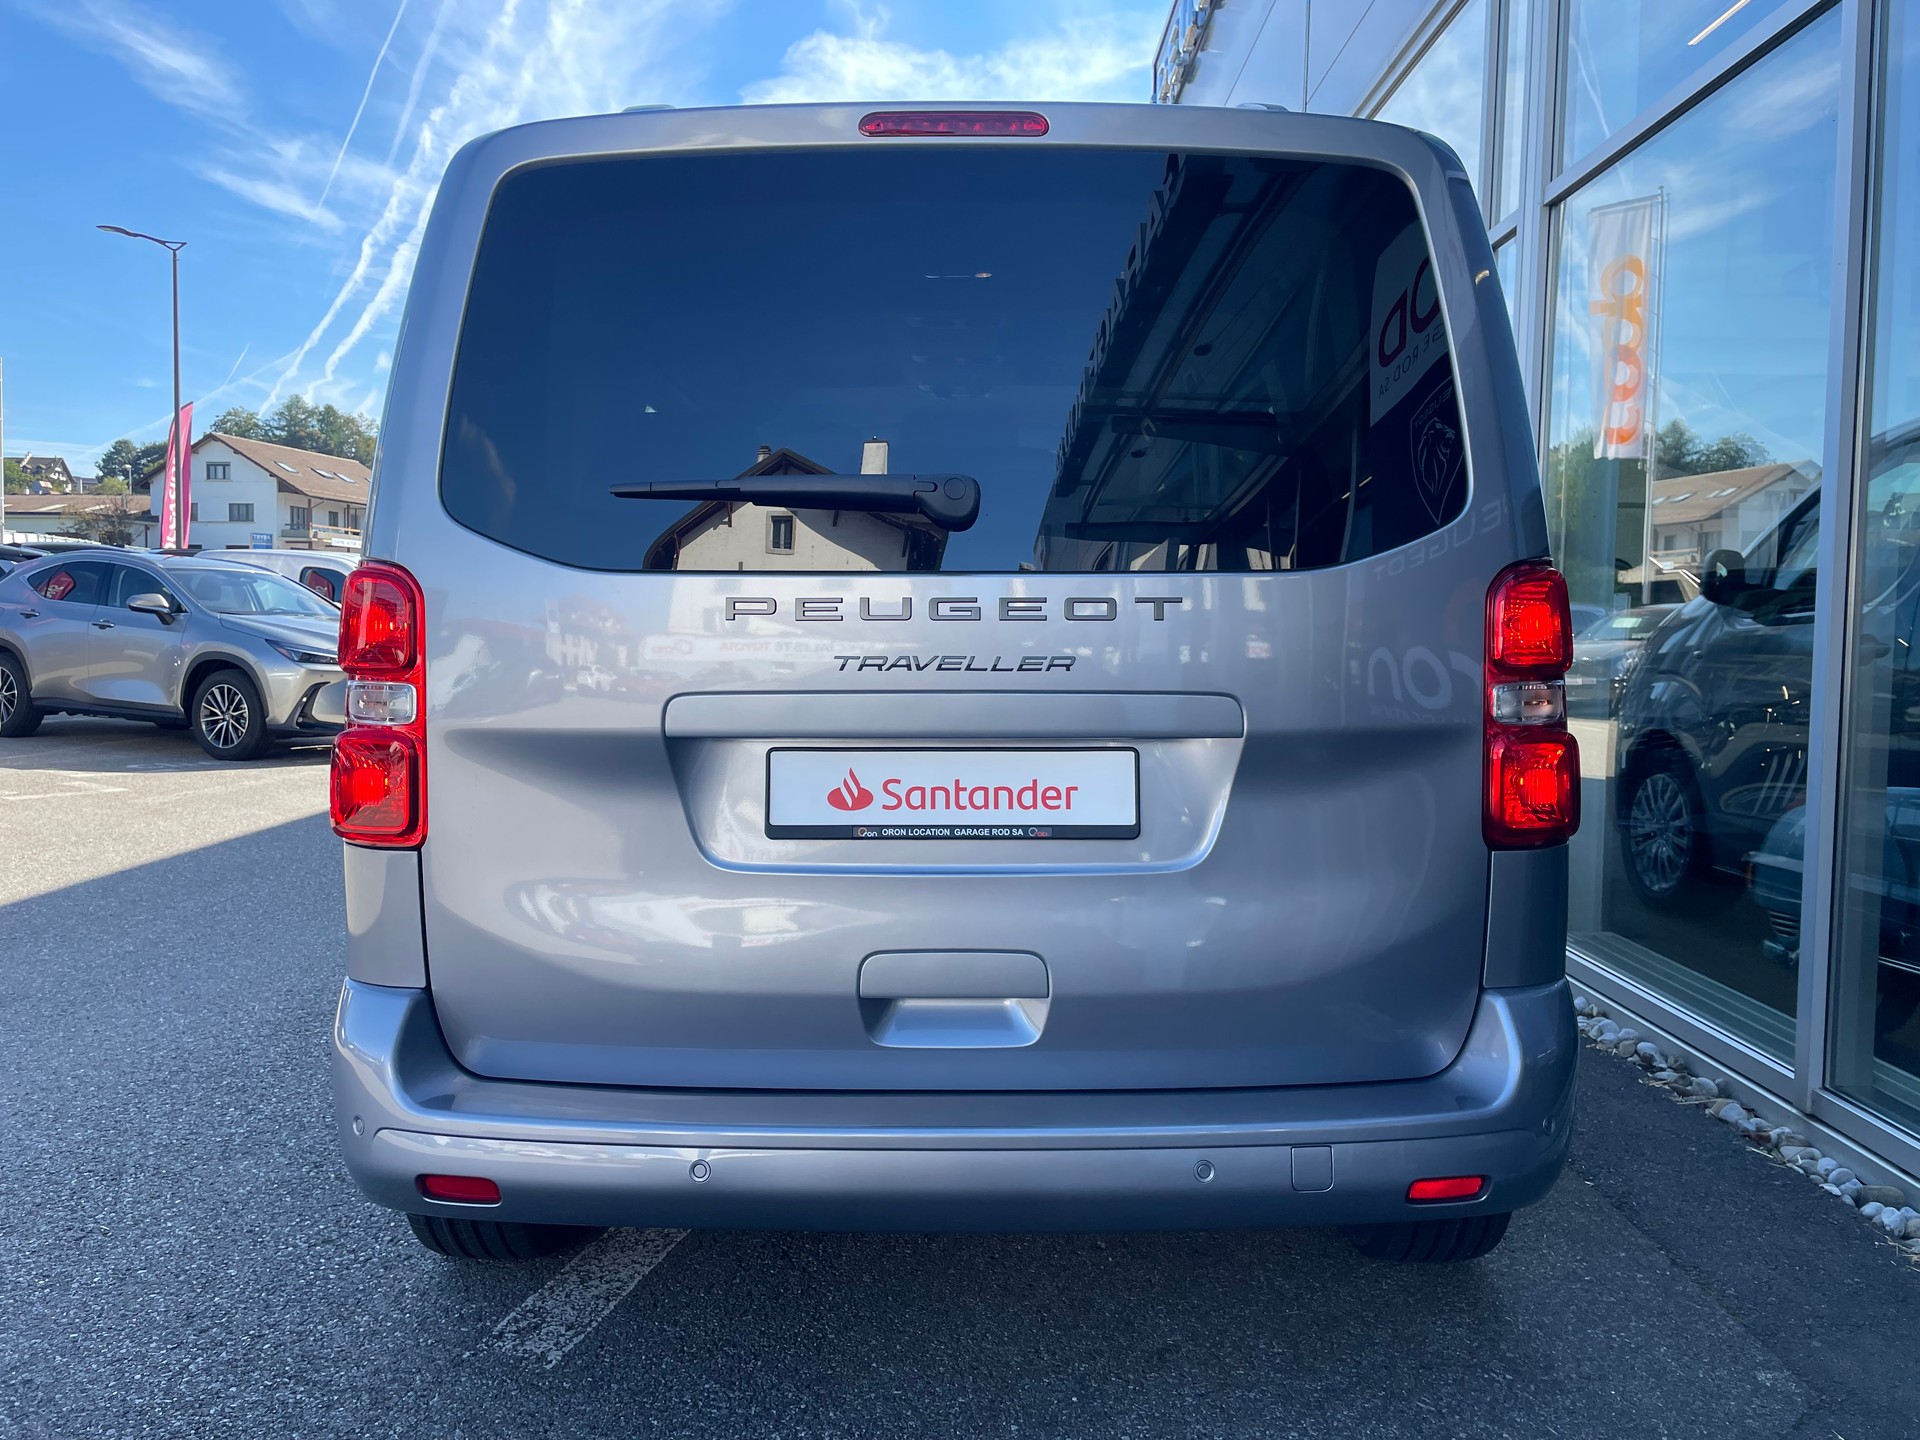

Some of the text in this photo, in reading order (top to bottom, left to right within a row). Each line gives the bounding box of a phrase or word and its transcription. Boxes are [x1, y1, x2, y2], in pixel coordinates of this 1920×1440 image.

[725, 596, 1183, 621] PEUGEOT
[833, 655, 1076, 672] TRAVELLER
[882, 777, 1079, 811] Santander
[881, 828, 906, 837] ORON
[908, 828, 950, 837] LOCATION
[954, 828, 990, 837] GARAGE
[992, 828, 1010, 837] ROD
[1012, 828, 1024, 837] SA
